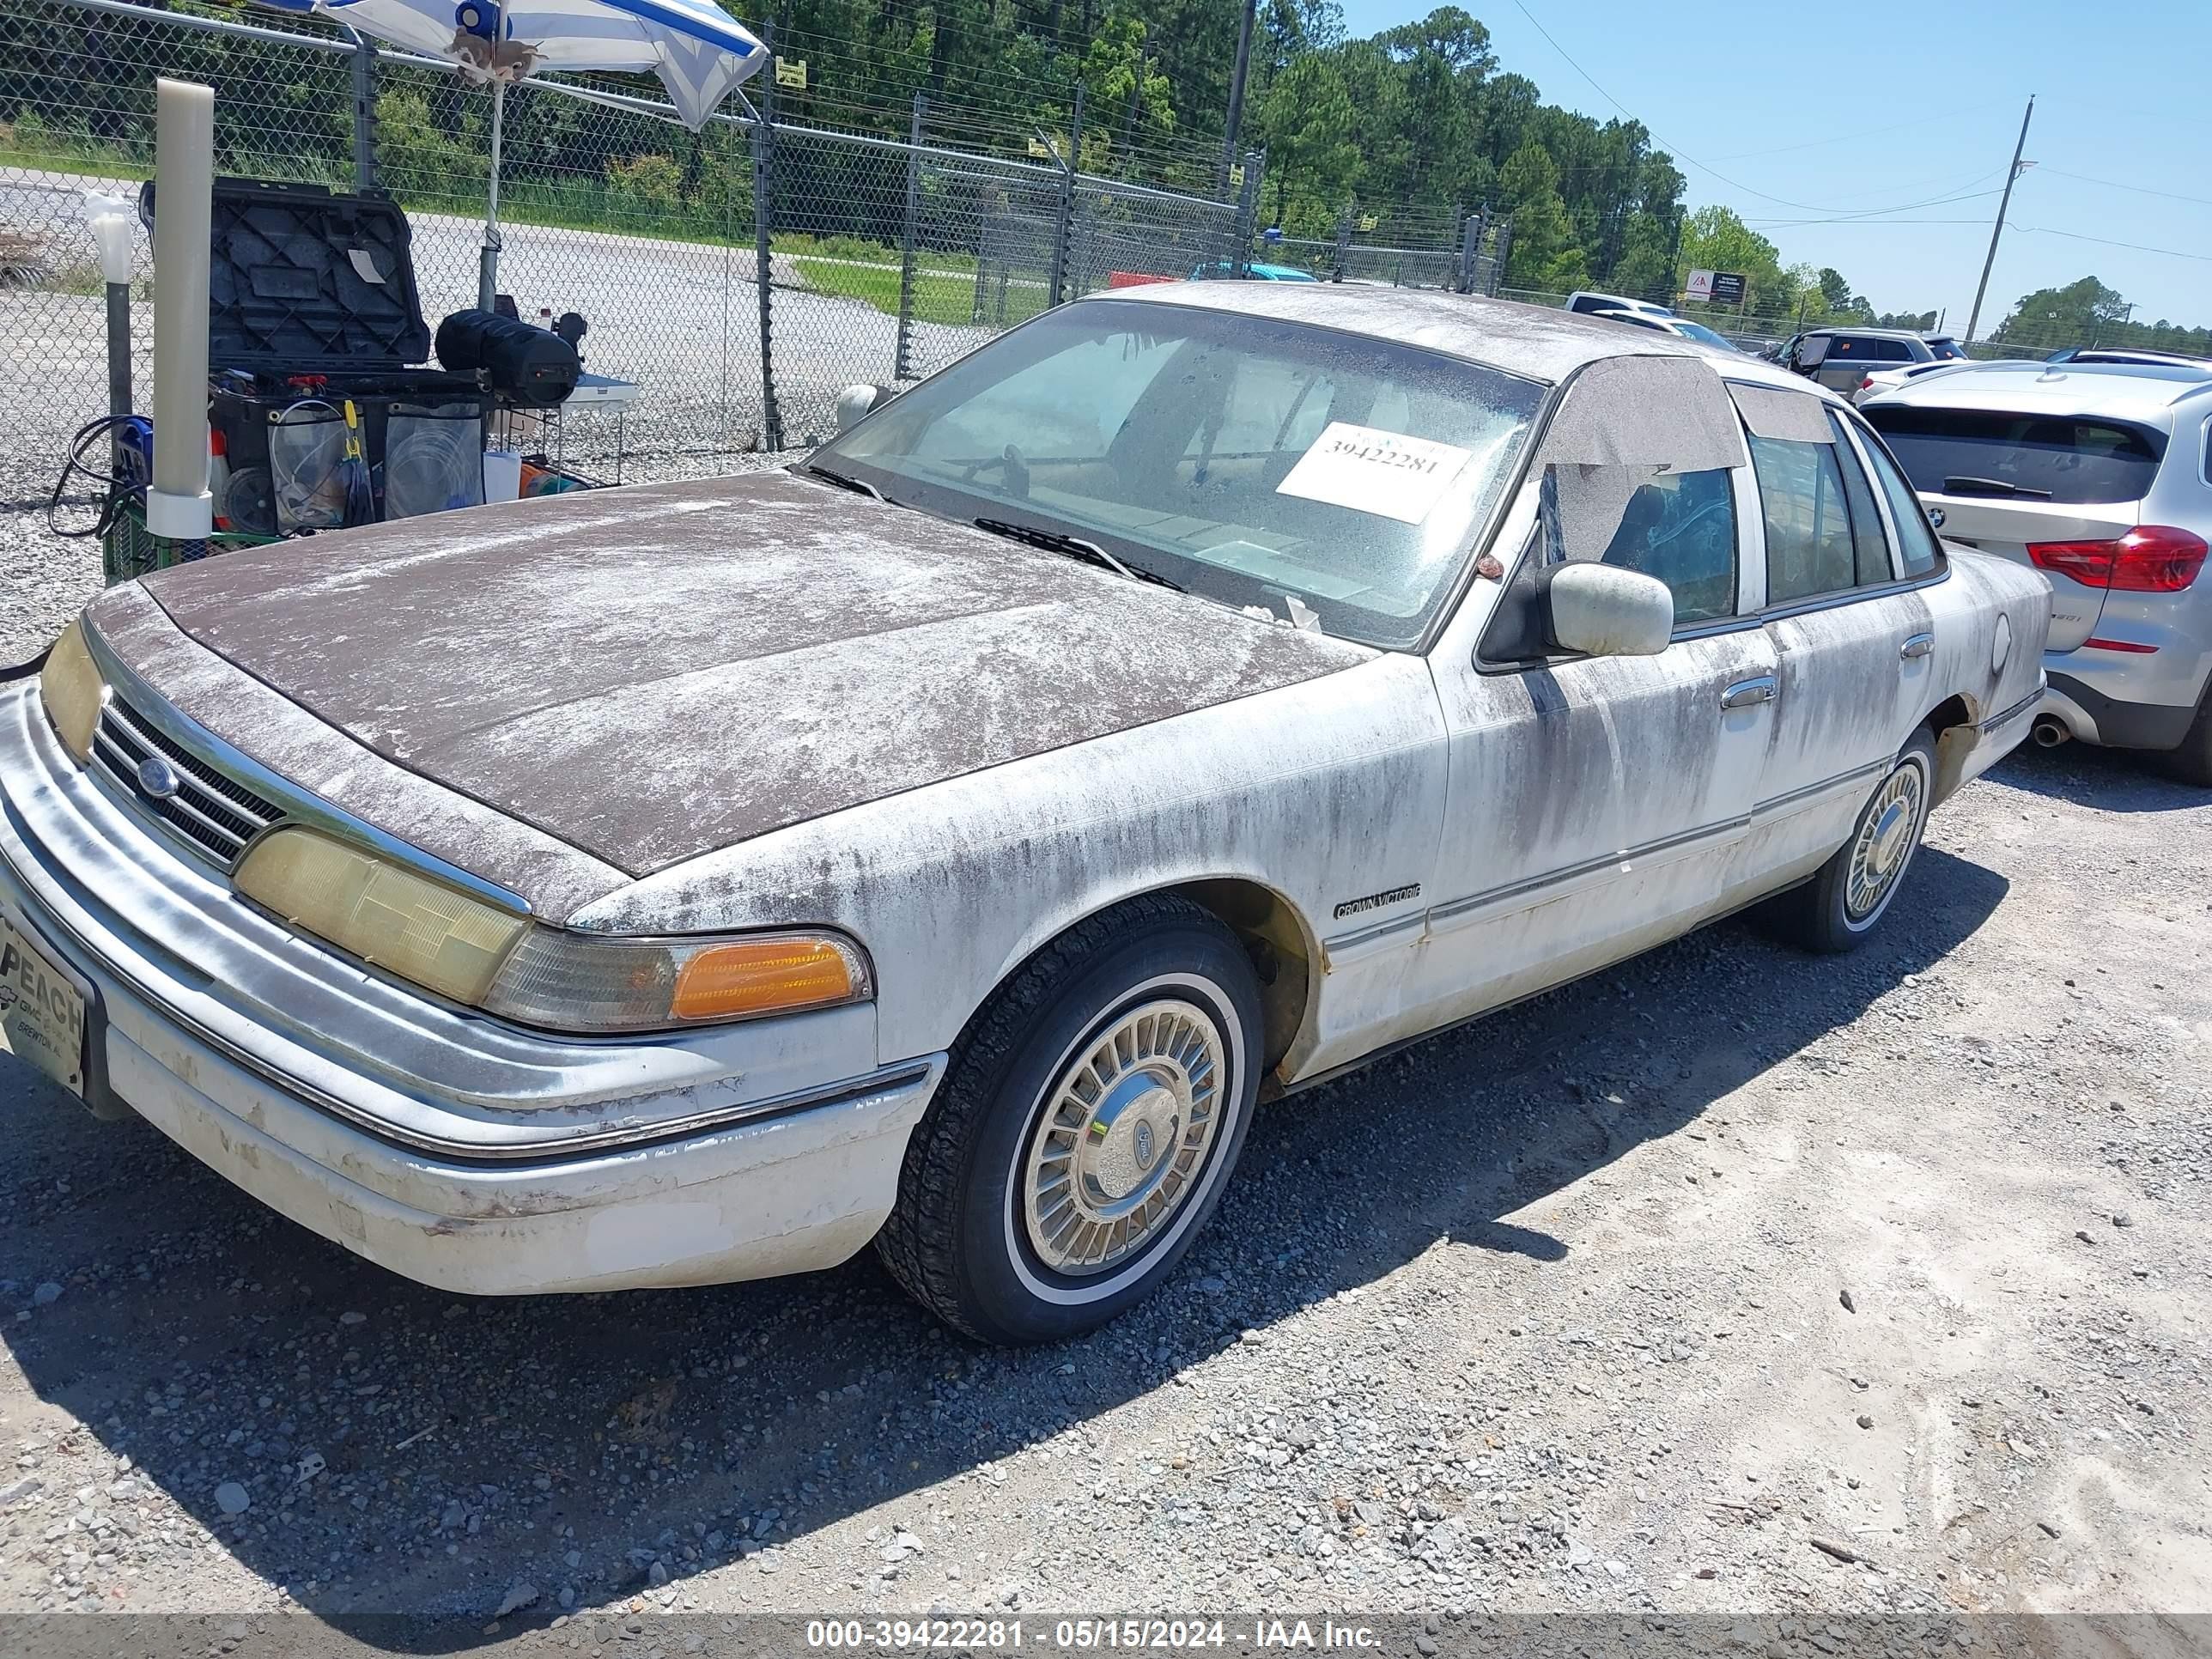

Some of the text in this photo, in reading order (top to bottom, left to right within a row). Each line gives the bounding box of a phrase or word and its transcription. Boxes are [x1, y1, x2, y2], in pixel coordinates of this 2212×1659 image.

[1324, 441, 1438, 474] 39422281
[1337, 897, 1375, 919] CROWN
[1, 942, 82, 1042] PEACH
[20, 1000, 41, 1022] GMC
[1139, 1133, 1151, 1159] Ford
